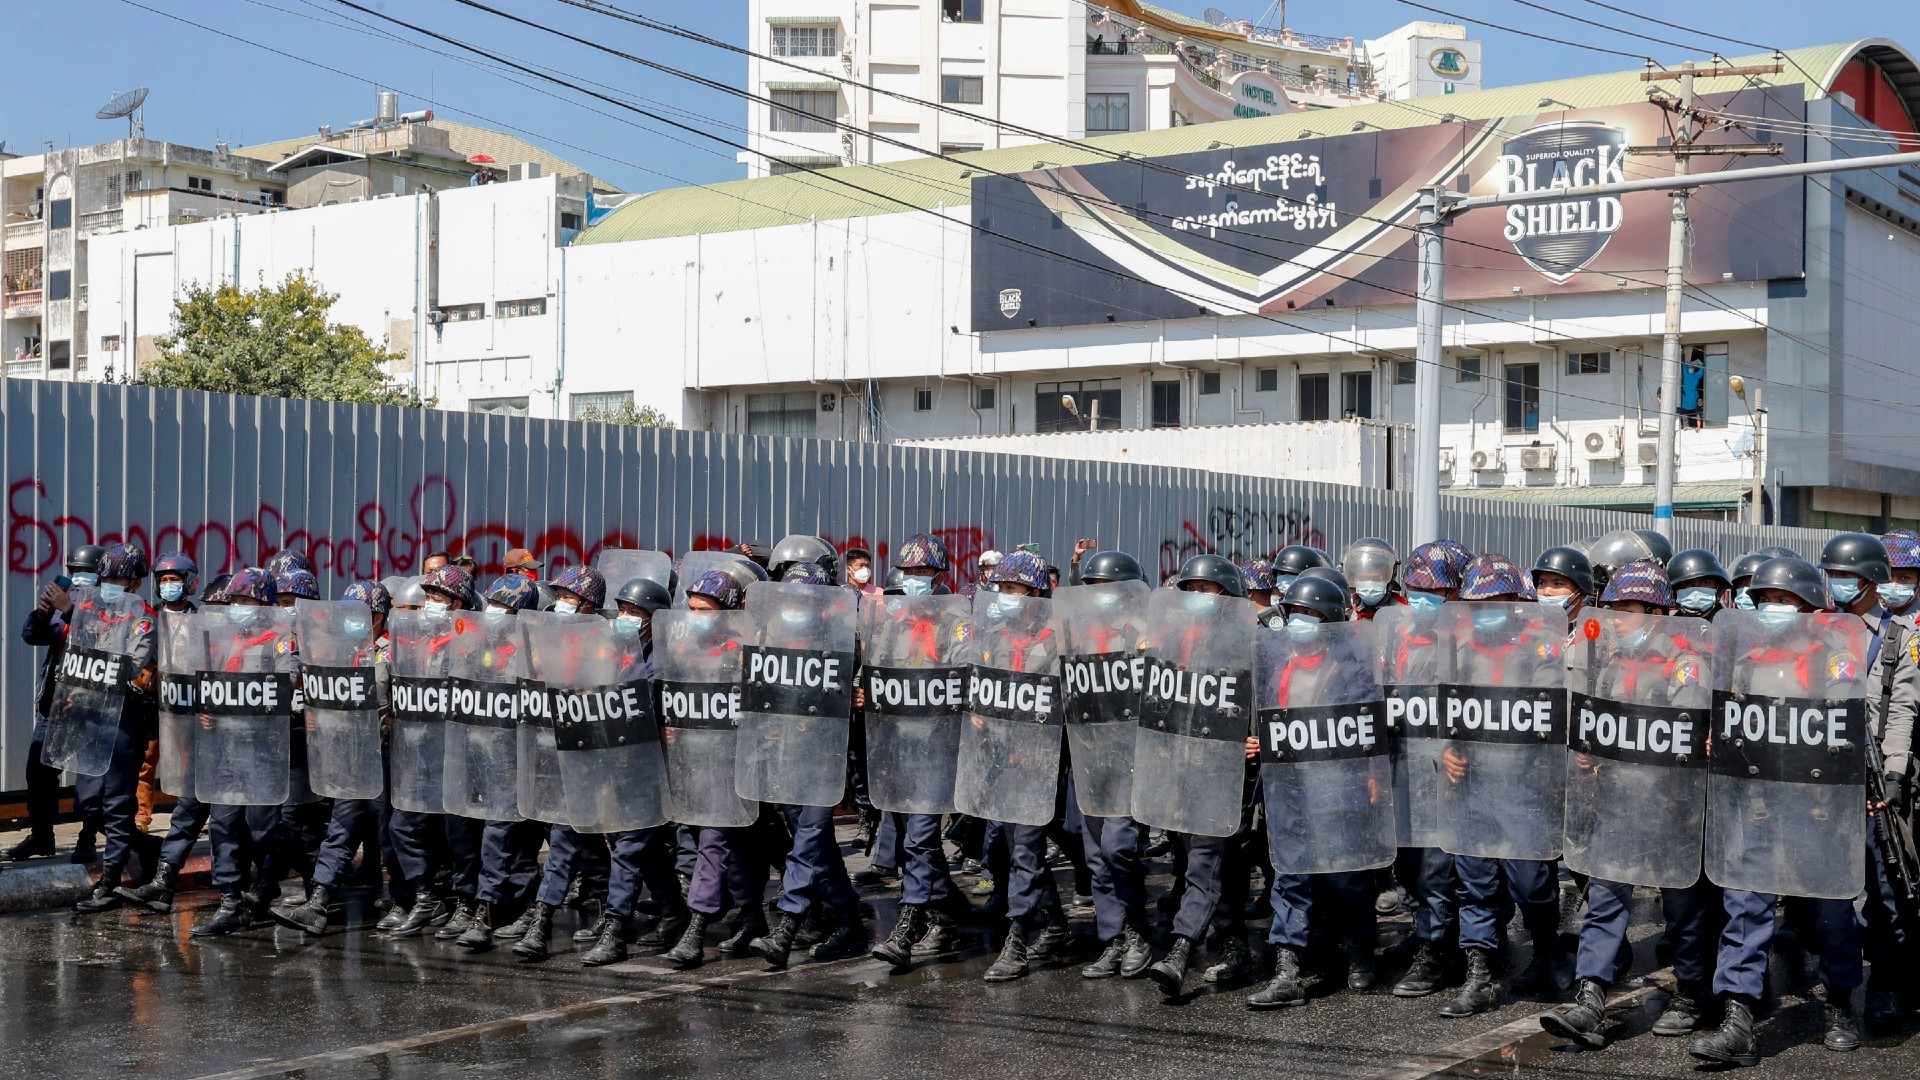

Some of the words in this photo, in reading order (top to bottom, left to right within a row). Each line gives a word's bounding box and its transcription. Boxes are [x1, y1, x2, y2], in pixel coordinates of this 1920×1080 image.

[1242, 82, 1278, 106] HOTEL
[1497, 143, 1629, 196] BLACK
[1525, 151, 1561, 161] SUPERIOR
[1563, 148, 1596, 158] QUALITY
[1503, 196, 1624, 243] SHIELD
[999, 292, 1022, 304] BLACK
[61, 652, 120, 685] POLICE
[750, 652, 840, 689] POLICE
[1064, 657, 1146, 694] POLICE
[161, 680, 196, 707] POLI
[200, 680, 278, 706] POLICE
[302, 672, 366, 701] POLICE
[520, 688, 552, 718] POL
[870, 676, 963, 706] POLICE
[968, 675, 1053, 713] POLICE
[1148, 664, 1237, 709] POLICE
[555, 687, 641, 723] POLICE
[661, 690, 743, 720] POLICE
[1386, 696, 1439, 726] POL
[1447, 696, 1552, 732] POLICE
[1269, 714, 1376, 752] POLICE
[1579, 707, 1693, 755] POLICE
[1724, 700, 1848, 747] POLICE
